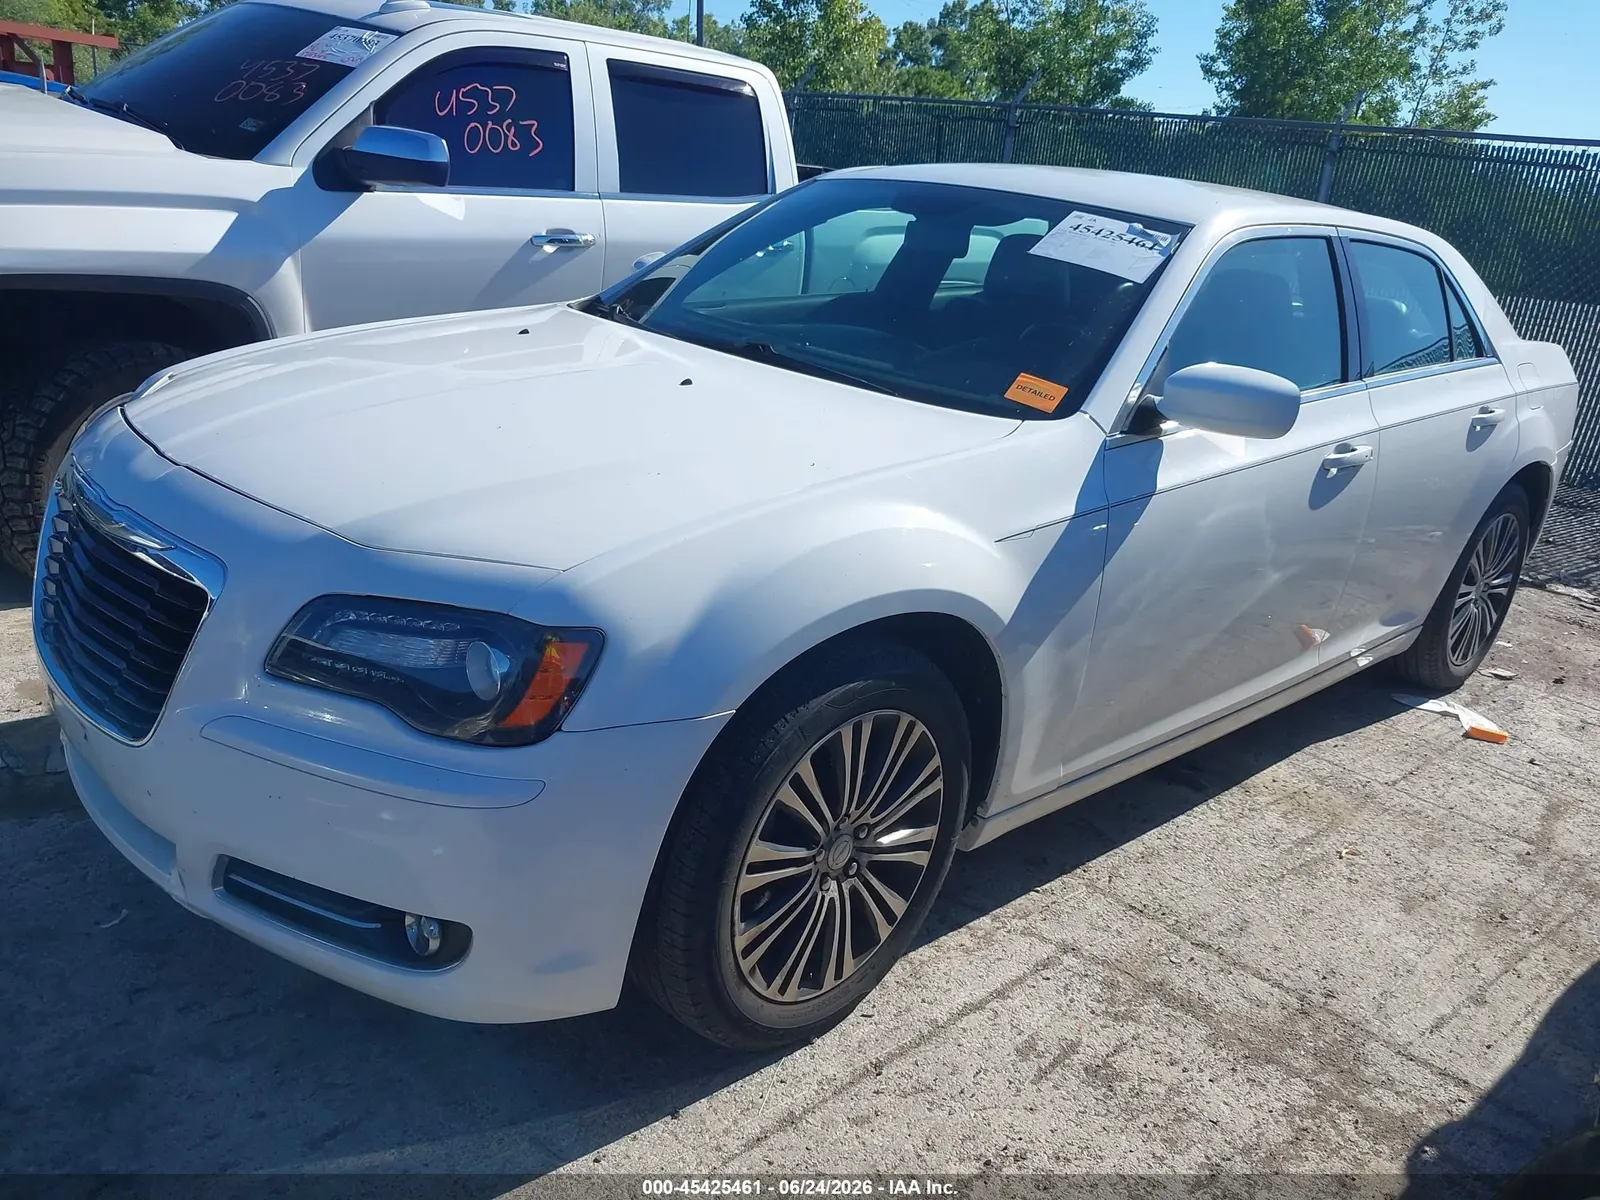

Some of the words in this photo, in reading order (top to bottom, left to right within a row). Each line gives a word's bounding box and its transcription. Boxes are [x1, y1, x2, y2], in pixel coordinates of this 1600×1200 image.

[240, 58, 321, 80] 4537
[214, 79, 308, 106] 0083
[435, 83, 517, 117] 4537
[464, 118, 544, 157] 0083
[1069, 222, 1159, 251] 45425461
[1015, 384, 1056, 402] DETAILED
